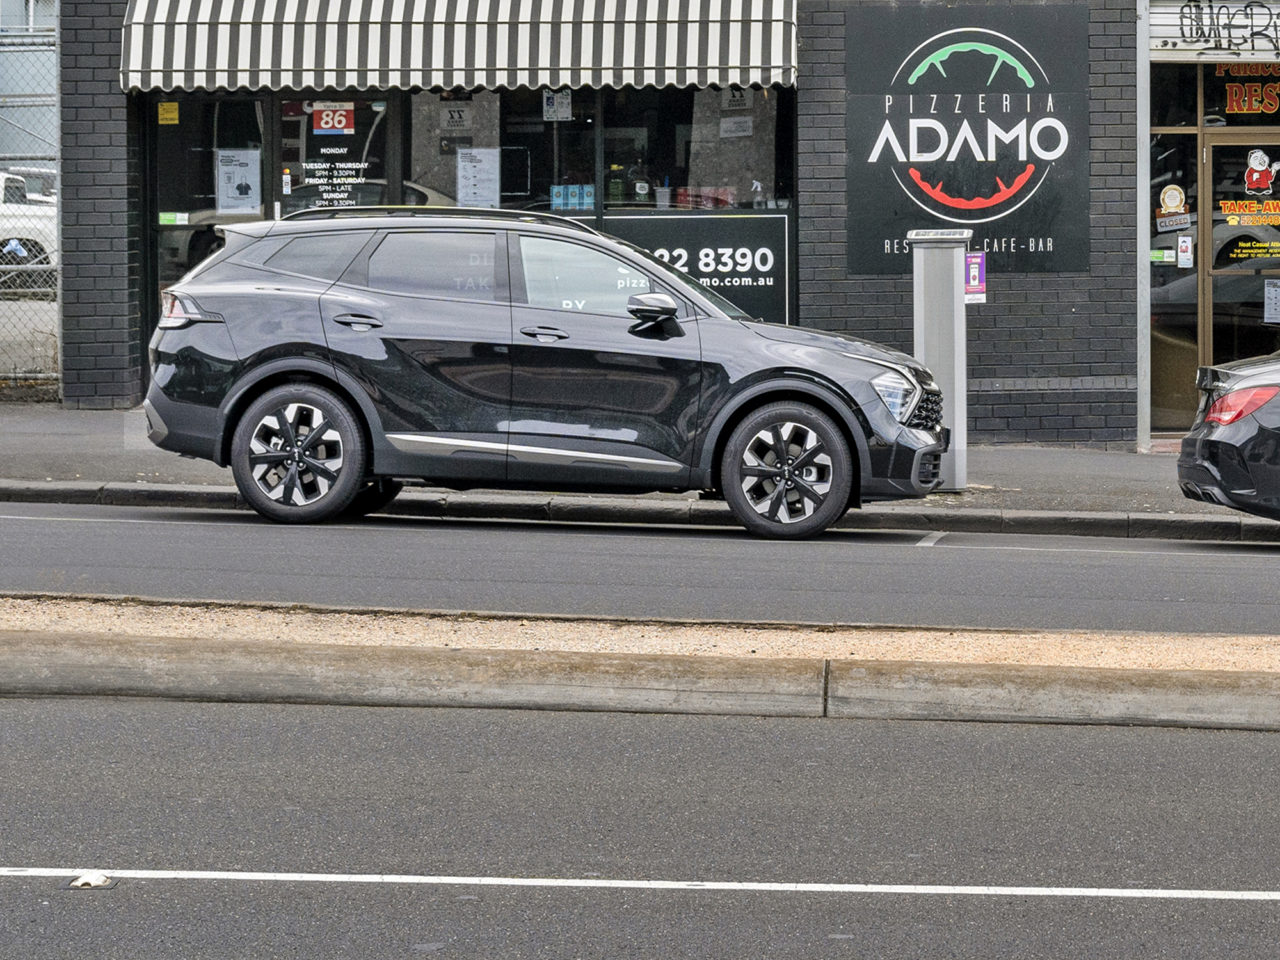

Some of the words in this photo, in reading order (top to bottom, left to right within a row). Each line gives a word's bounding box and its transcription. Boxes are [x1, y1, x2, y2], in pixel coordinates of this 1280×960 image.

[885, 94, 1054, 114] PIZZERIA
[320, 110, 347, 128] 86
[867, 117, 1069, 162] ADAMO
[1158, 217, 1188, 228] CLOSED
[698, 247, 775, 273] 8390
